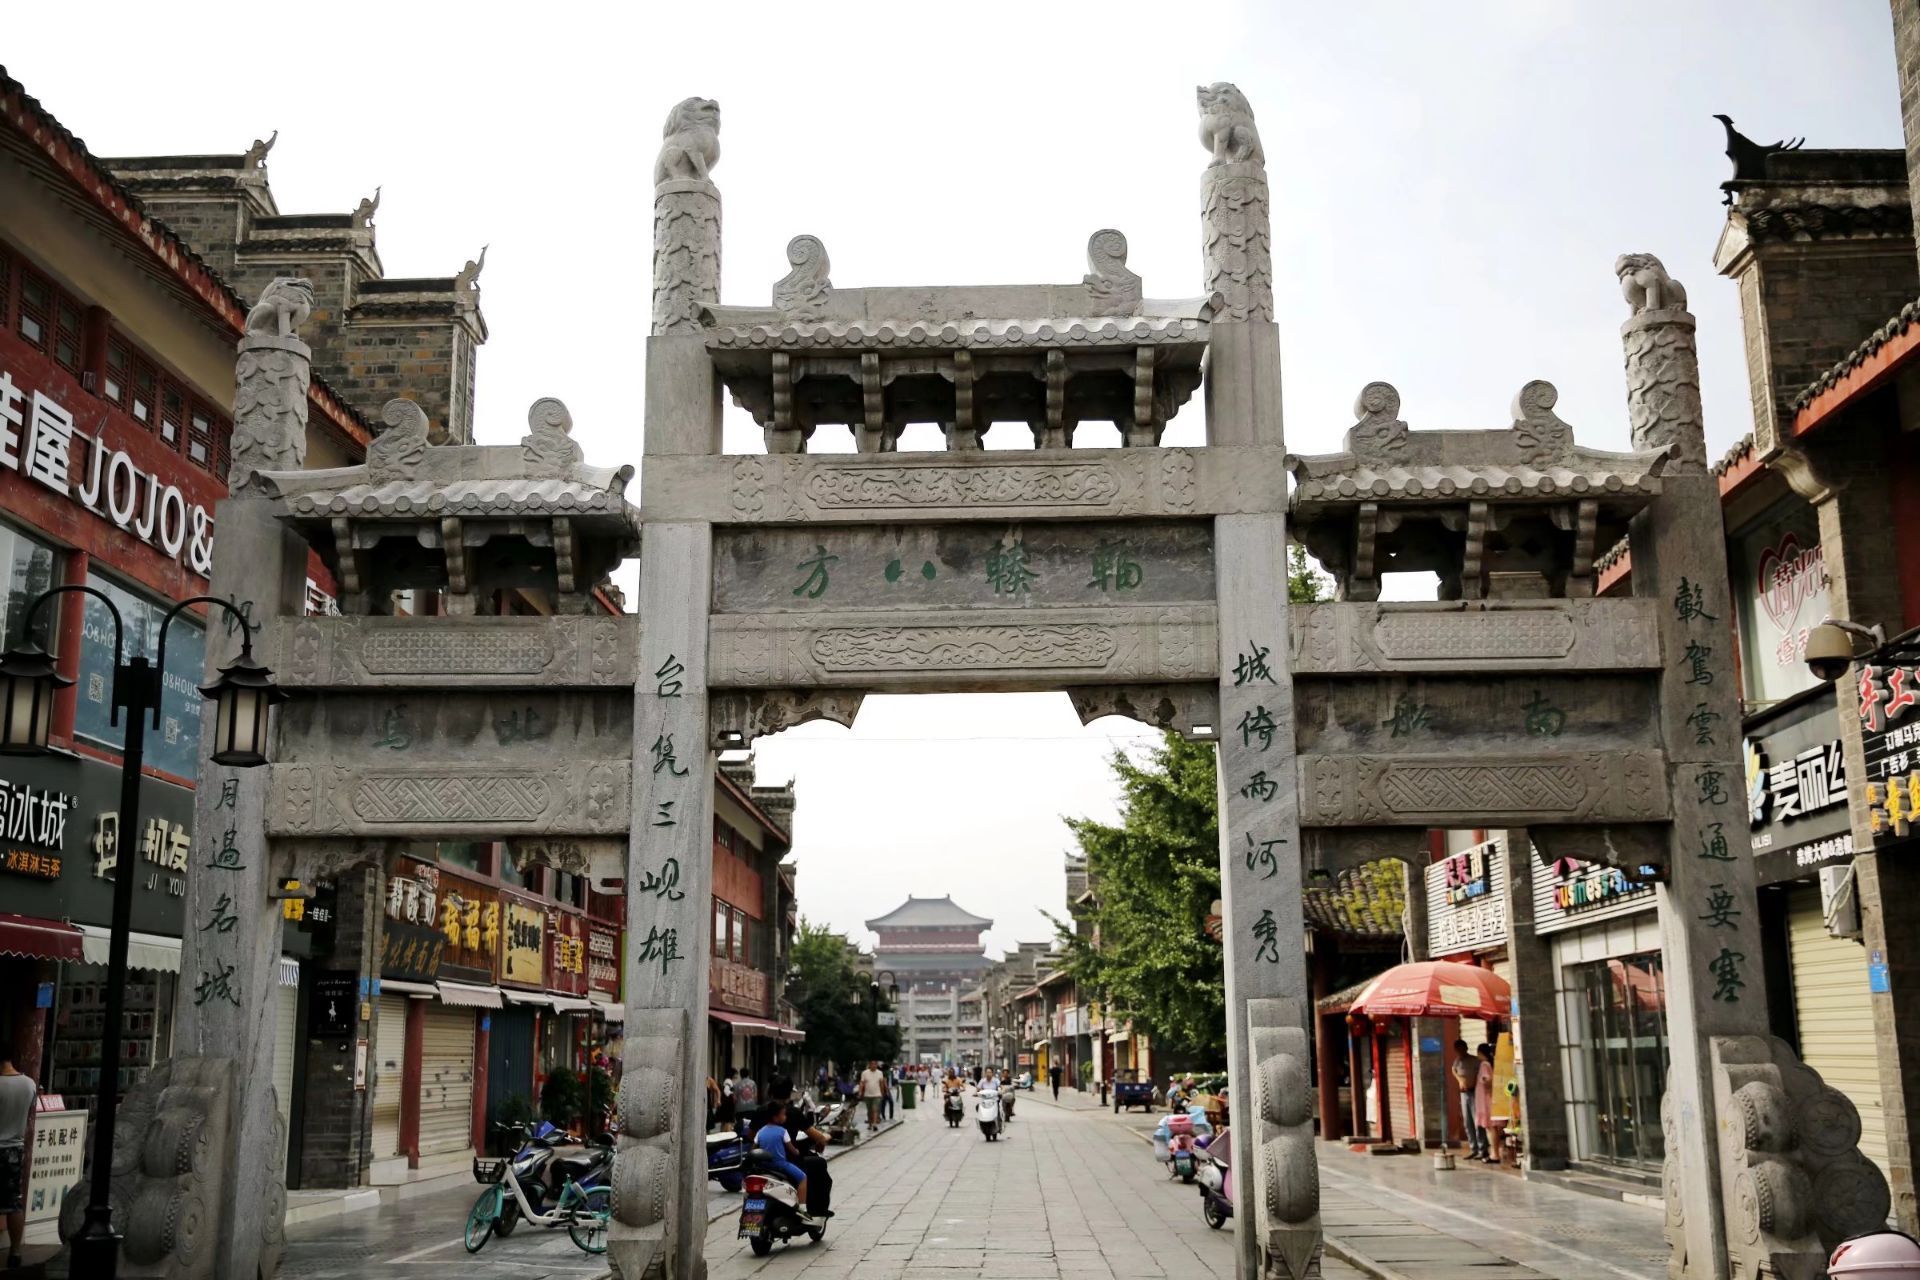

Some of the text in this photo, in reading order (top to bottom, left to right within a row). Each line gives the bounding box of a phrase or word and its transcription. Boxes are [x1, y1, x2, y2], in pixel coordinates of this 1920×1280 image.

[169, 876, 186, 897] YOU
[36, 1127, 78, 1148] 手机配件
